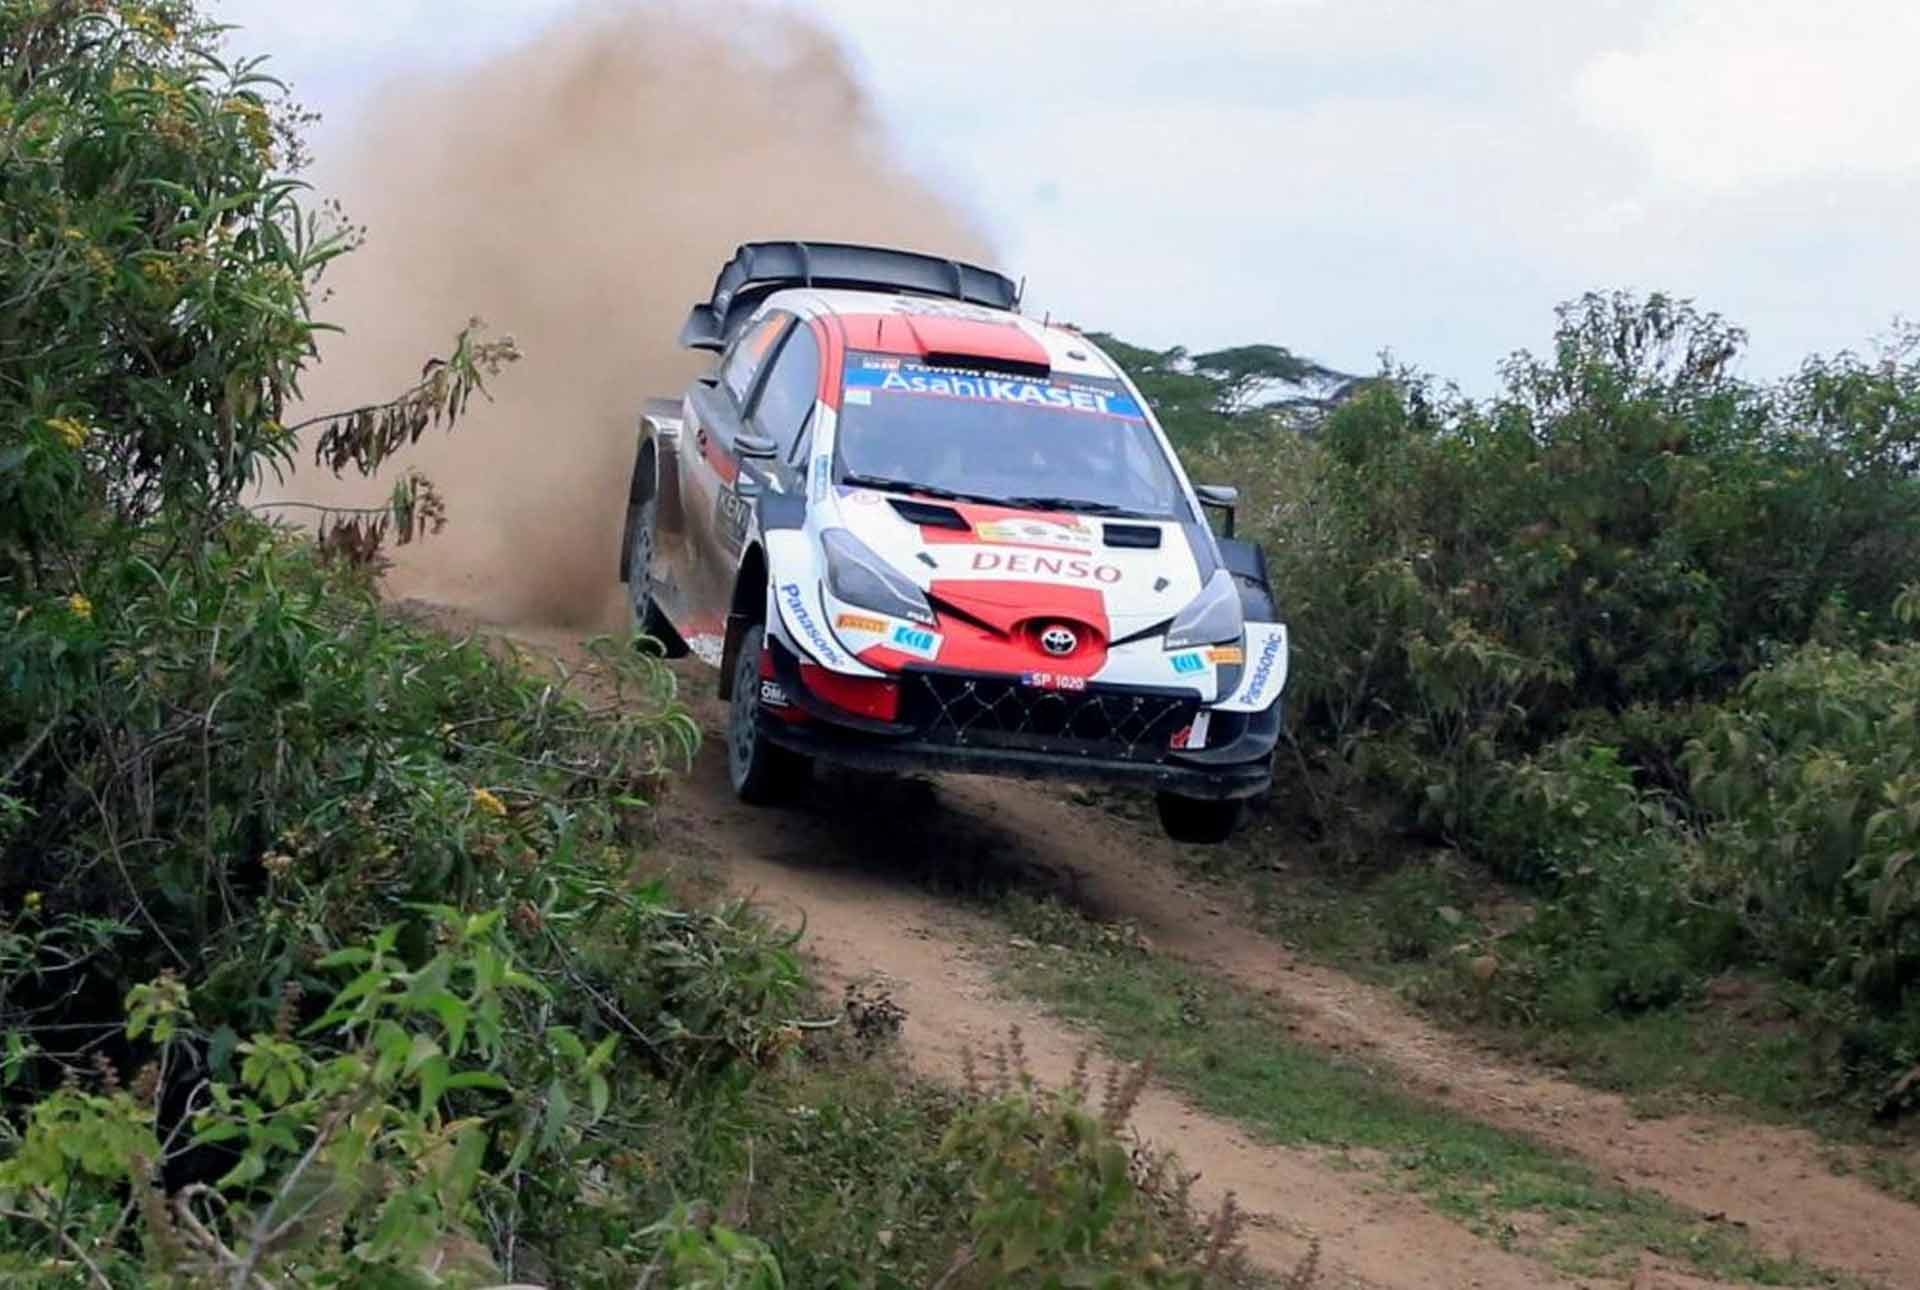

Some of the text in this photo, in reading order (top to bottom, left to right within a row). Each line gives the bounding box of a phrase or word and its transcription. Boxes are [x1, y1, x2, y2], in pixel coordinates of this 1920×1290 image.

[971, 552, 1123, 584] DENSO
[780, 583, 846, 667] Panasonic
[1031, 671, 1052, 688] SP
[1240, 632, 1283, 705] Panasonic
